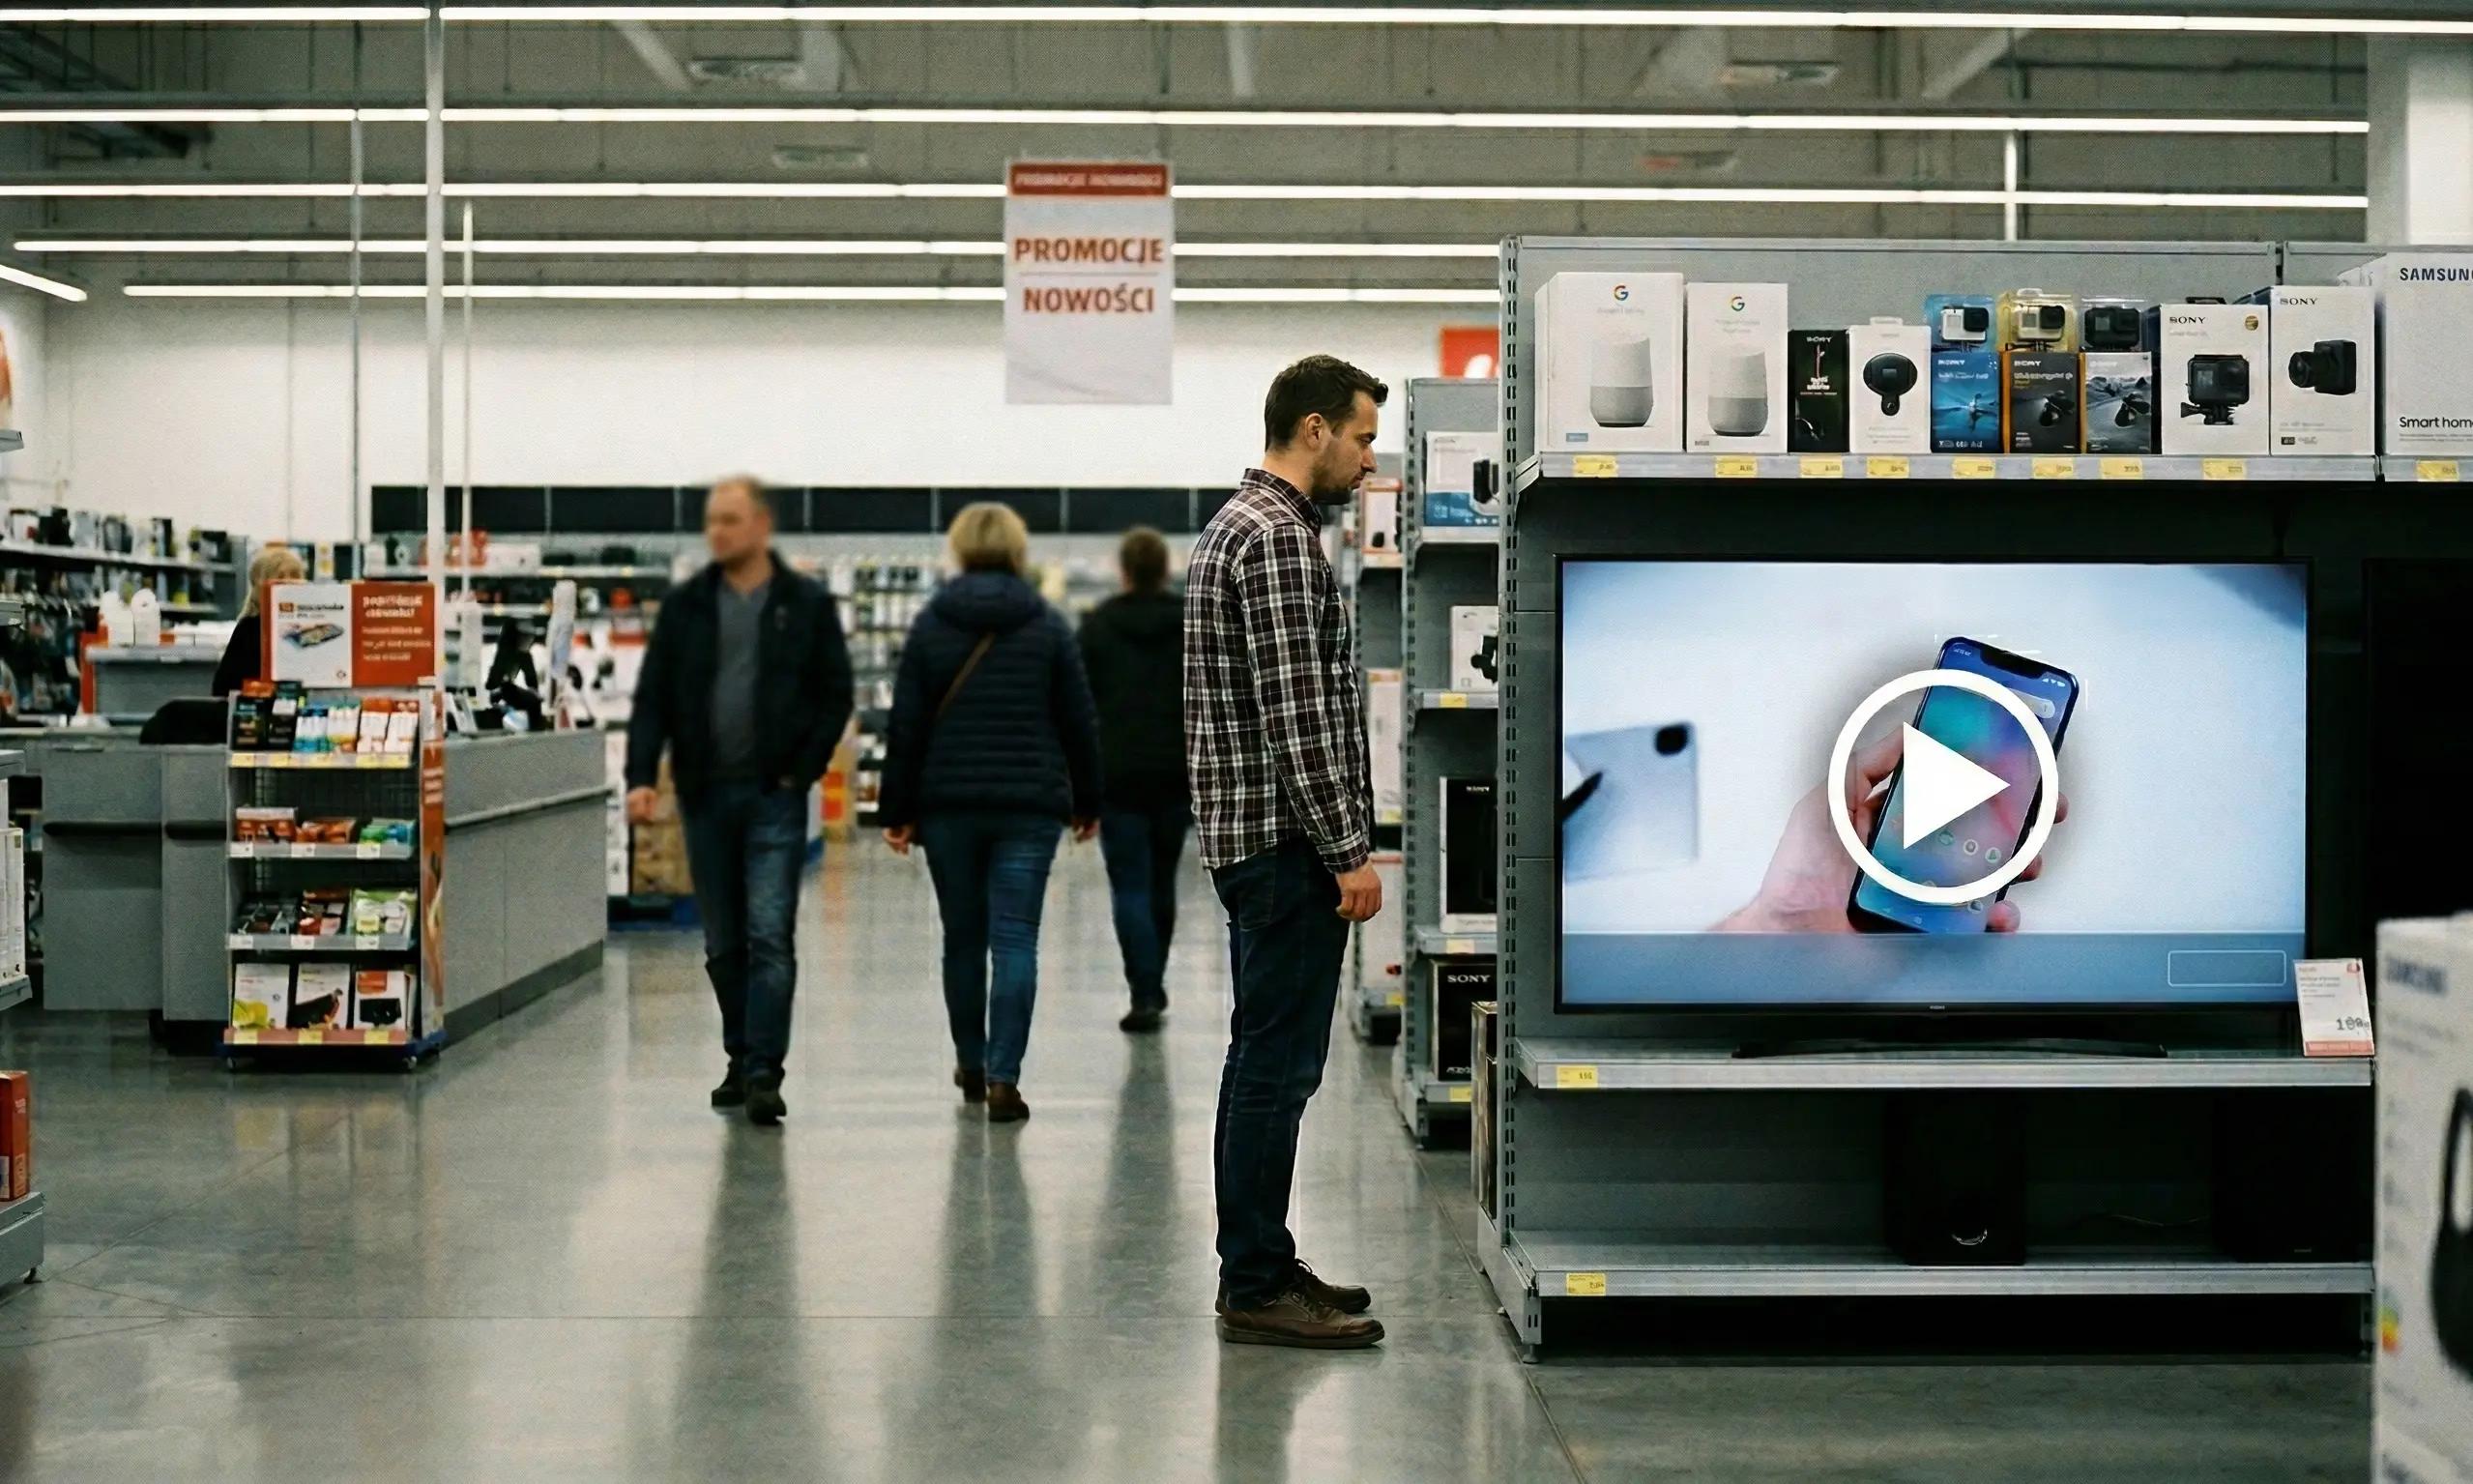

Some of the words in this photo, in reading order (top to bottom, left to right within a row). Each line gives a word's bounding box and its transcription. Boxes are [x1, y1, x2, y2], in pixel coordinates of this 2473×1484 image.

[1015, 238, 1163, 265] PROMOCJE
[2400, 268, 2473, 281] SAMSUN
[1023, 283, 1154, 312] NOWOŚCI
[2400, 417, 2439, 427] Smart
[2442, 417, 2473, 427] hom
